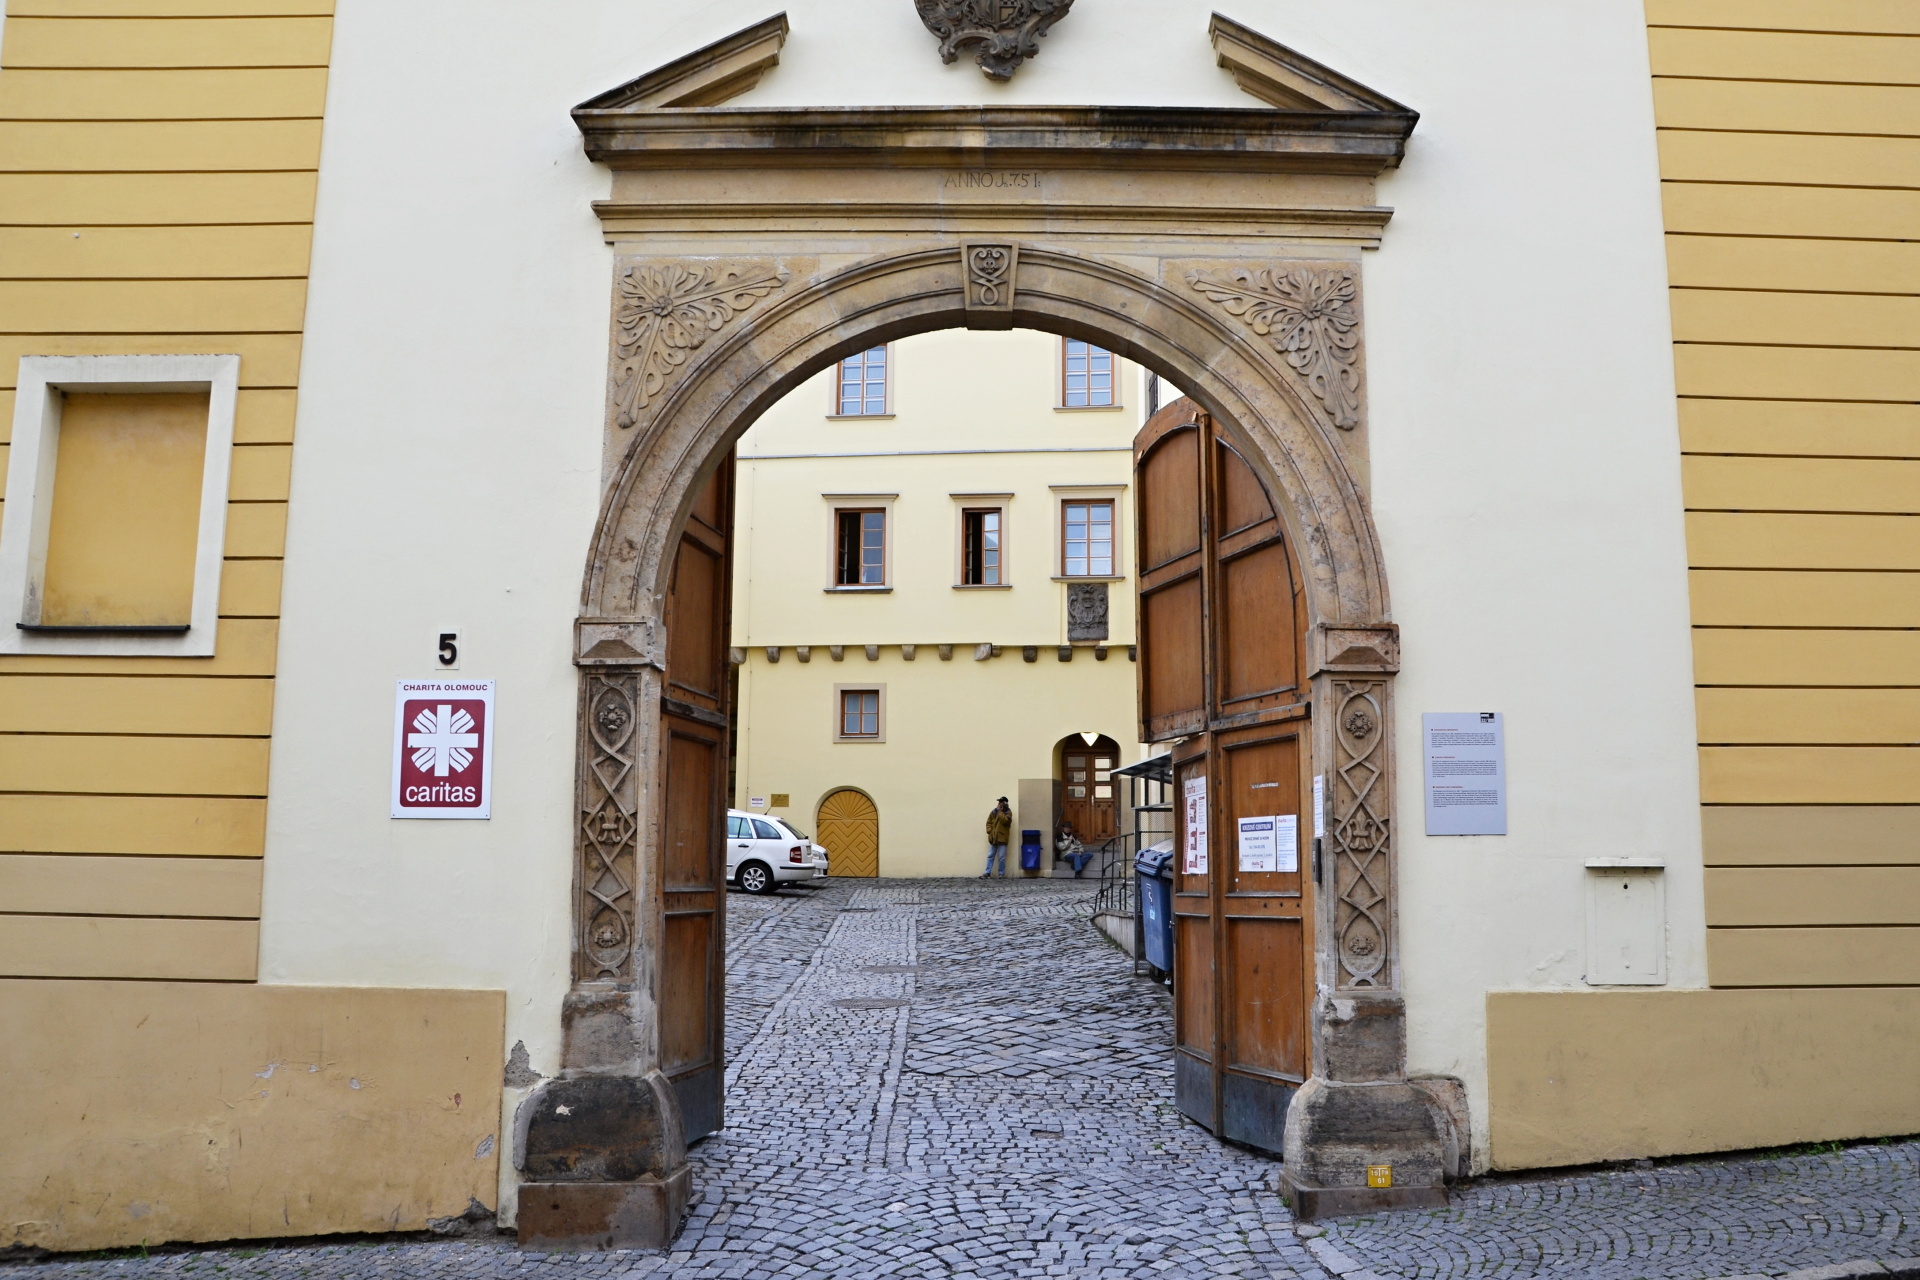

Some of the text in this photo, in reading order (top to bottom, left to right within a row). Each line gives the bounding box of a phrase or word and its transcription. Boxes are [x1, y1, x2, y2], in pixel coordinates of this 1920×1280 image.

[944, 172, 994, 188] ANNO
[438, 633, 457, 665] 5
[405, 781, 476, 803] caritas
